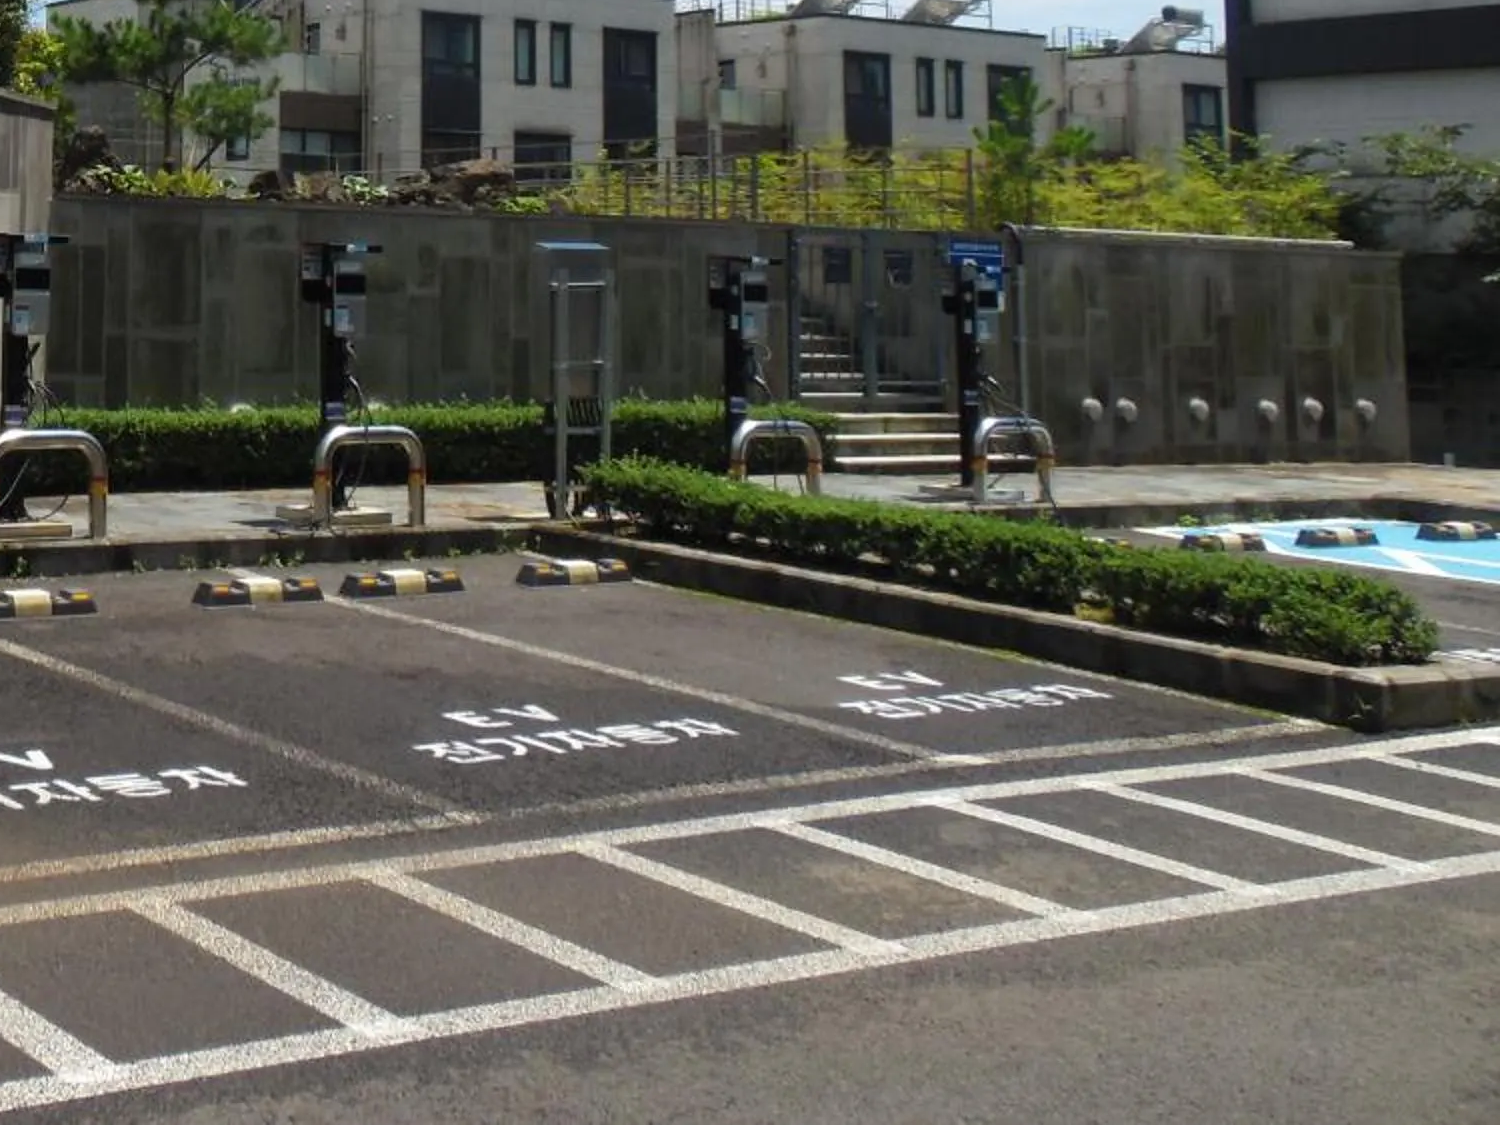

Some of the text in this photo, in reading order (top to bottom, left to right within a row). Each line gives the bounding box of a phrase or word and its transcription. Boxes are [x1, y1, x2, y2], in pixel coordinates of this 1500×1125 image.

[835, 670, 944, 691] EV
[442, 704, 560, 728] EV
[836, 683, 1113, 720] 전기자동차
[412, 717, 739, 764] 전기자동차
